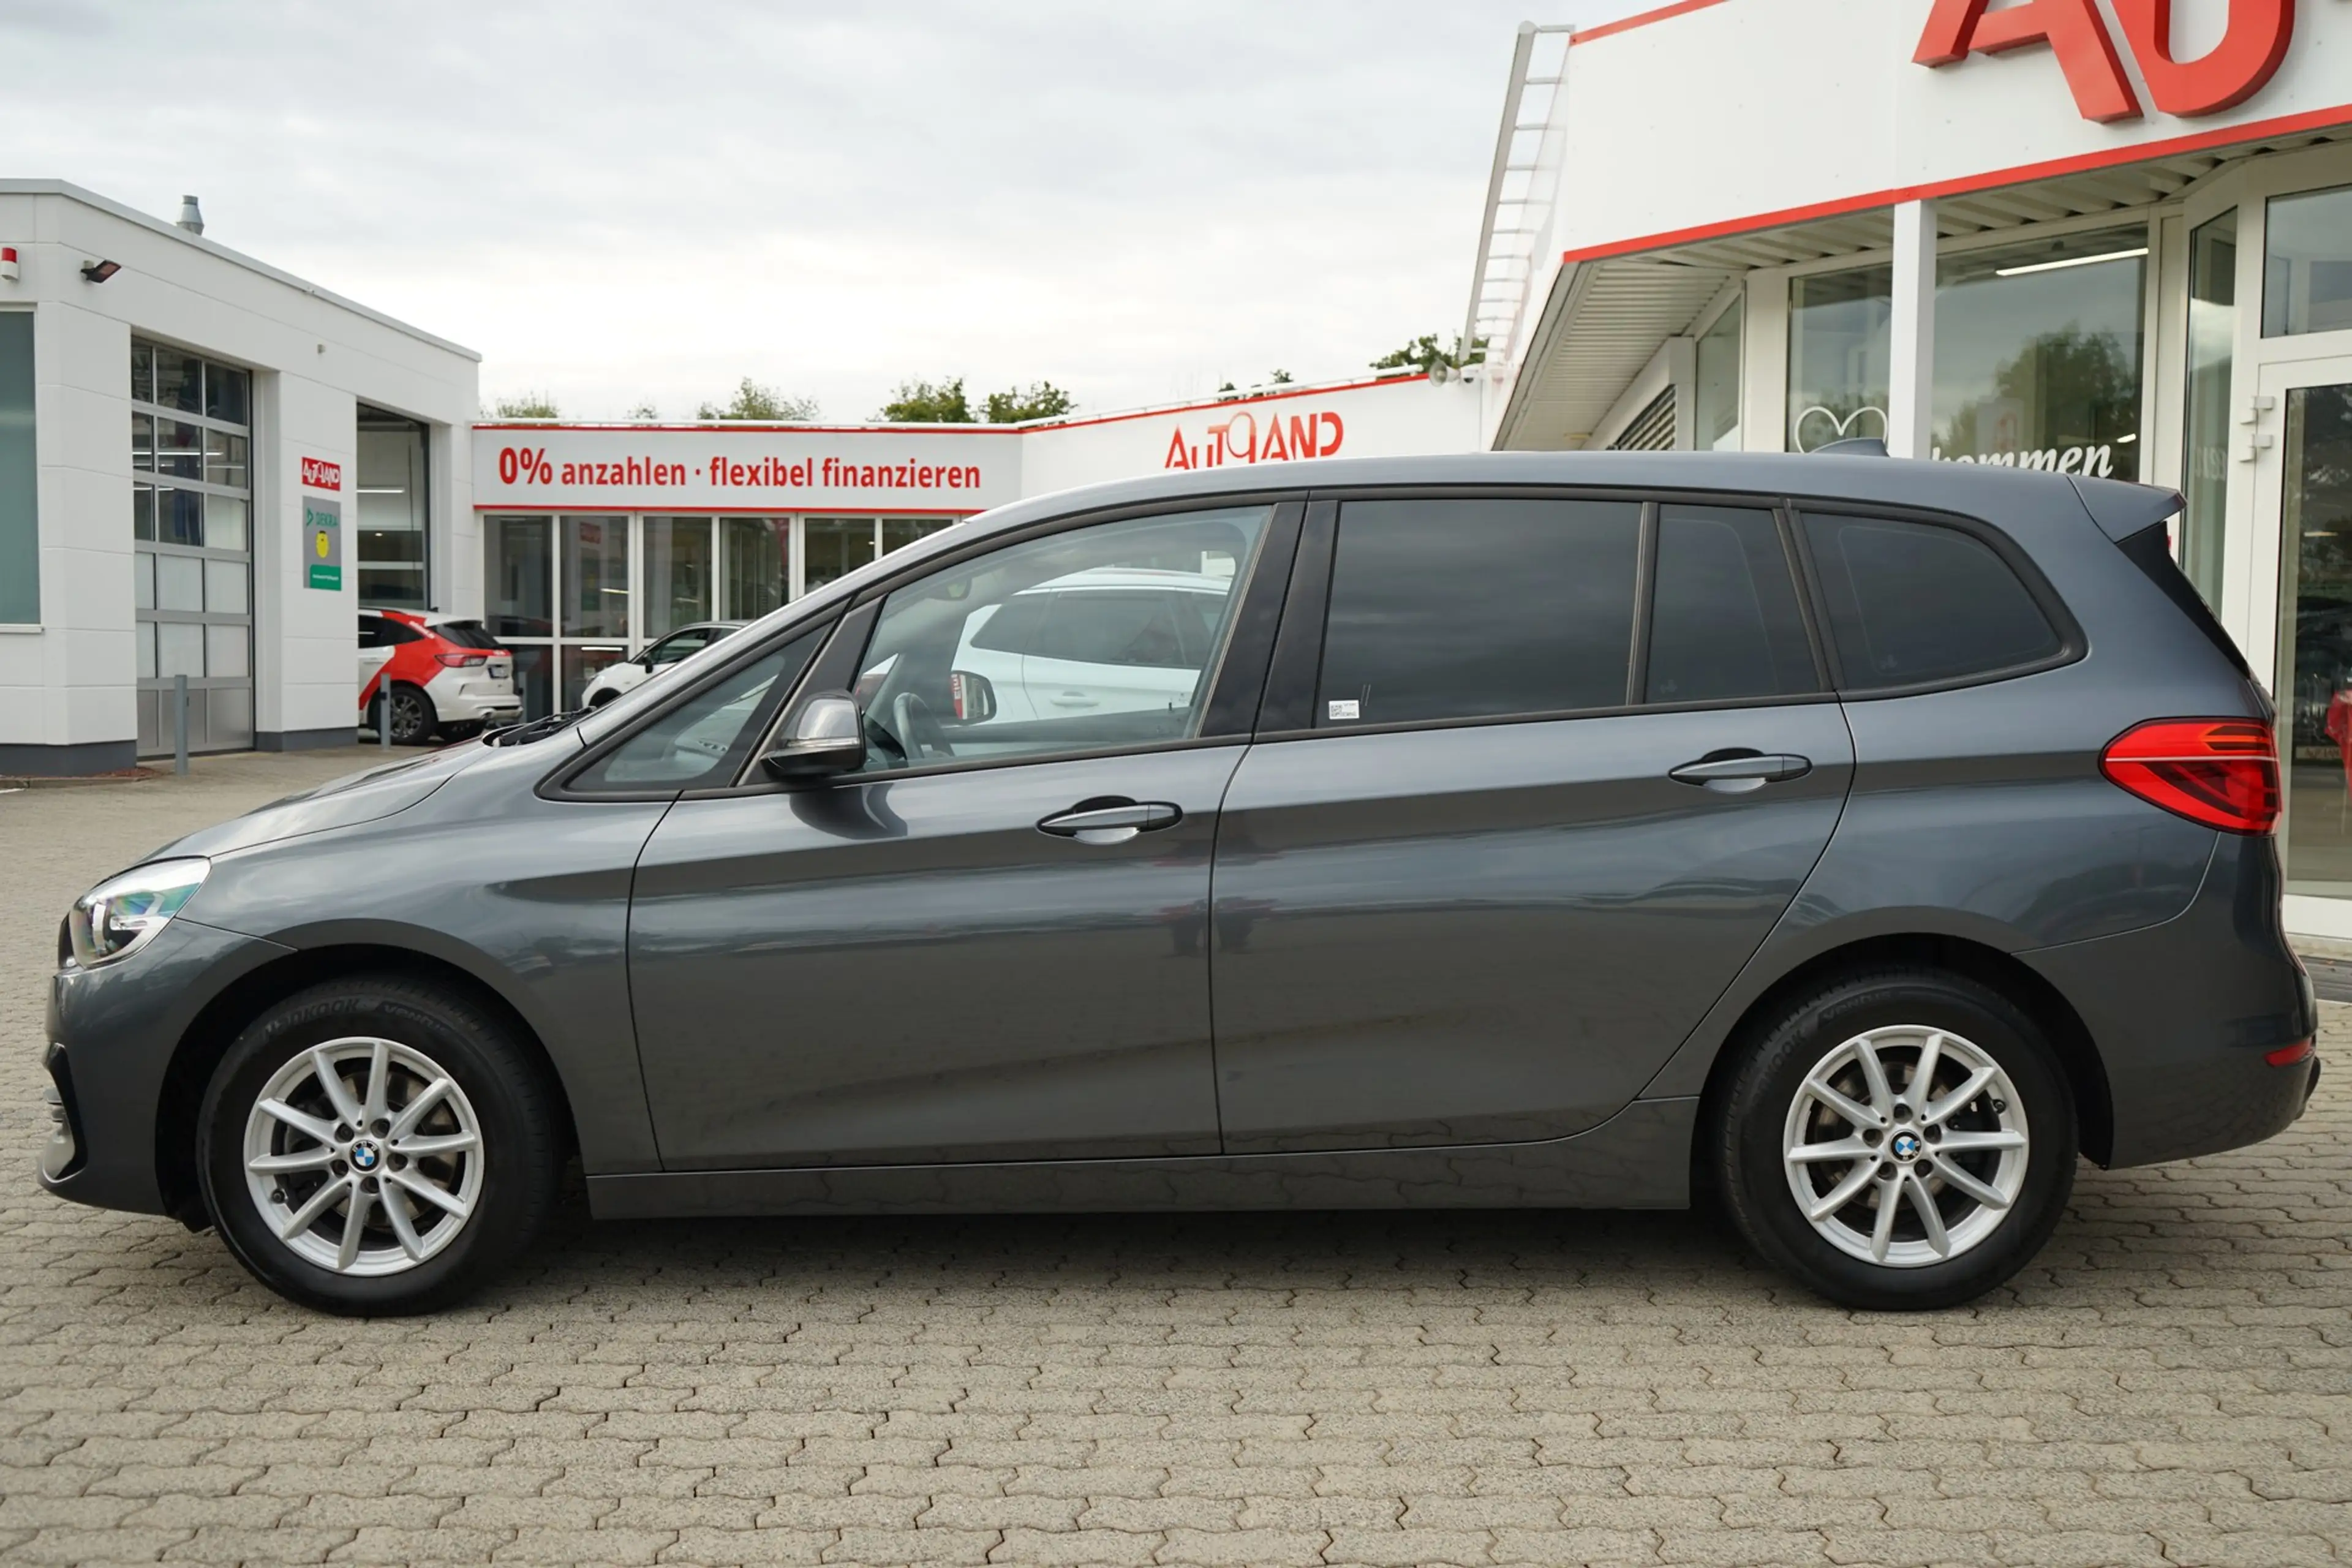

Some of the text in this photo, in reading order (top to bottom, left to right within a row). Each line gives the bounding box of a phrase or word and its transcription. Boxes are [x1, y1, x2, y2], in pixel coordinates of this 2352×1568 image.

[499, 447, 981, 489] 0% anzahlen flexibel finanzieren
